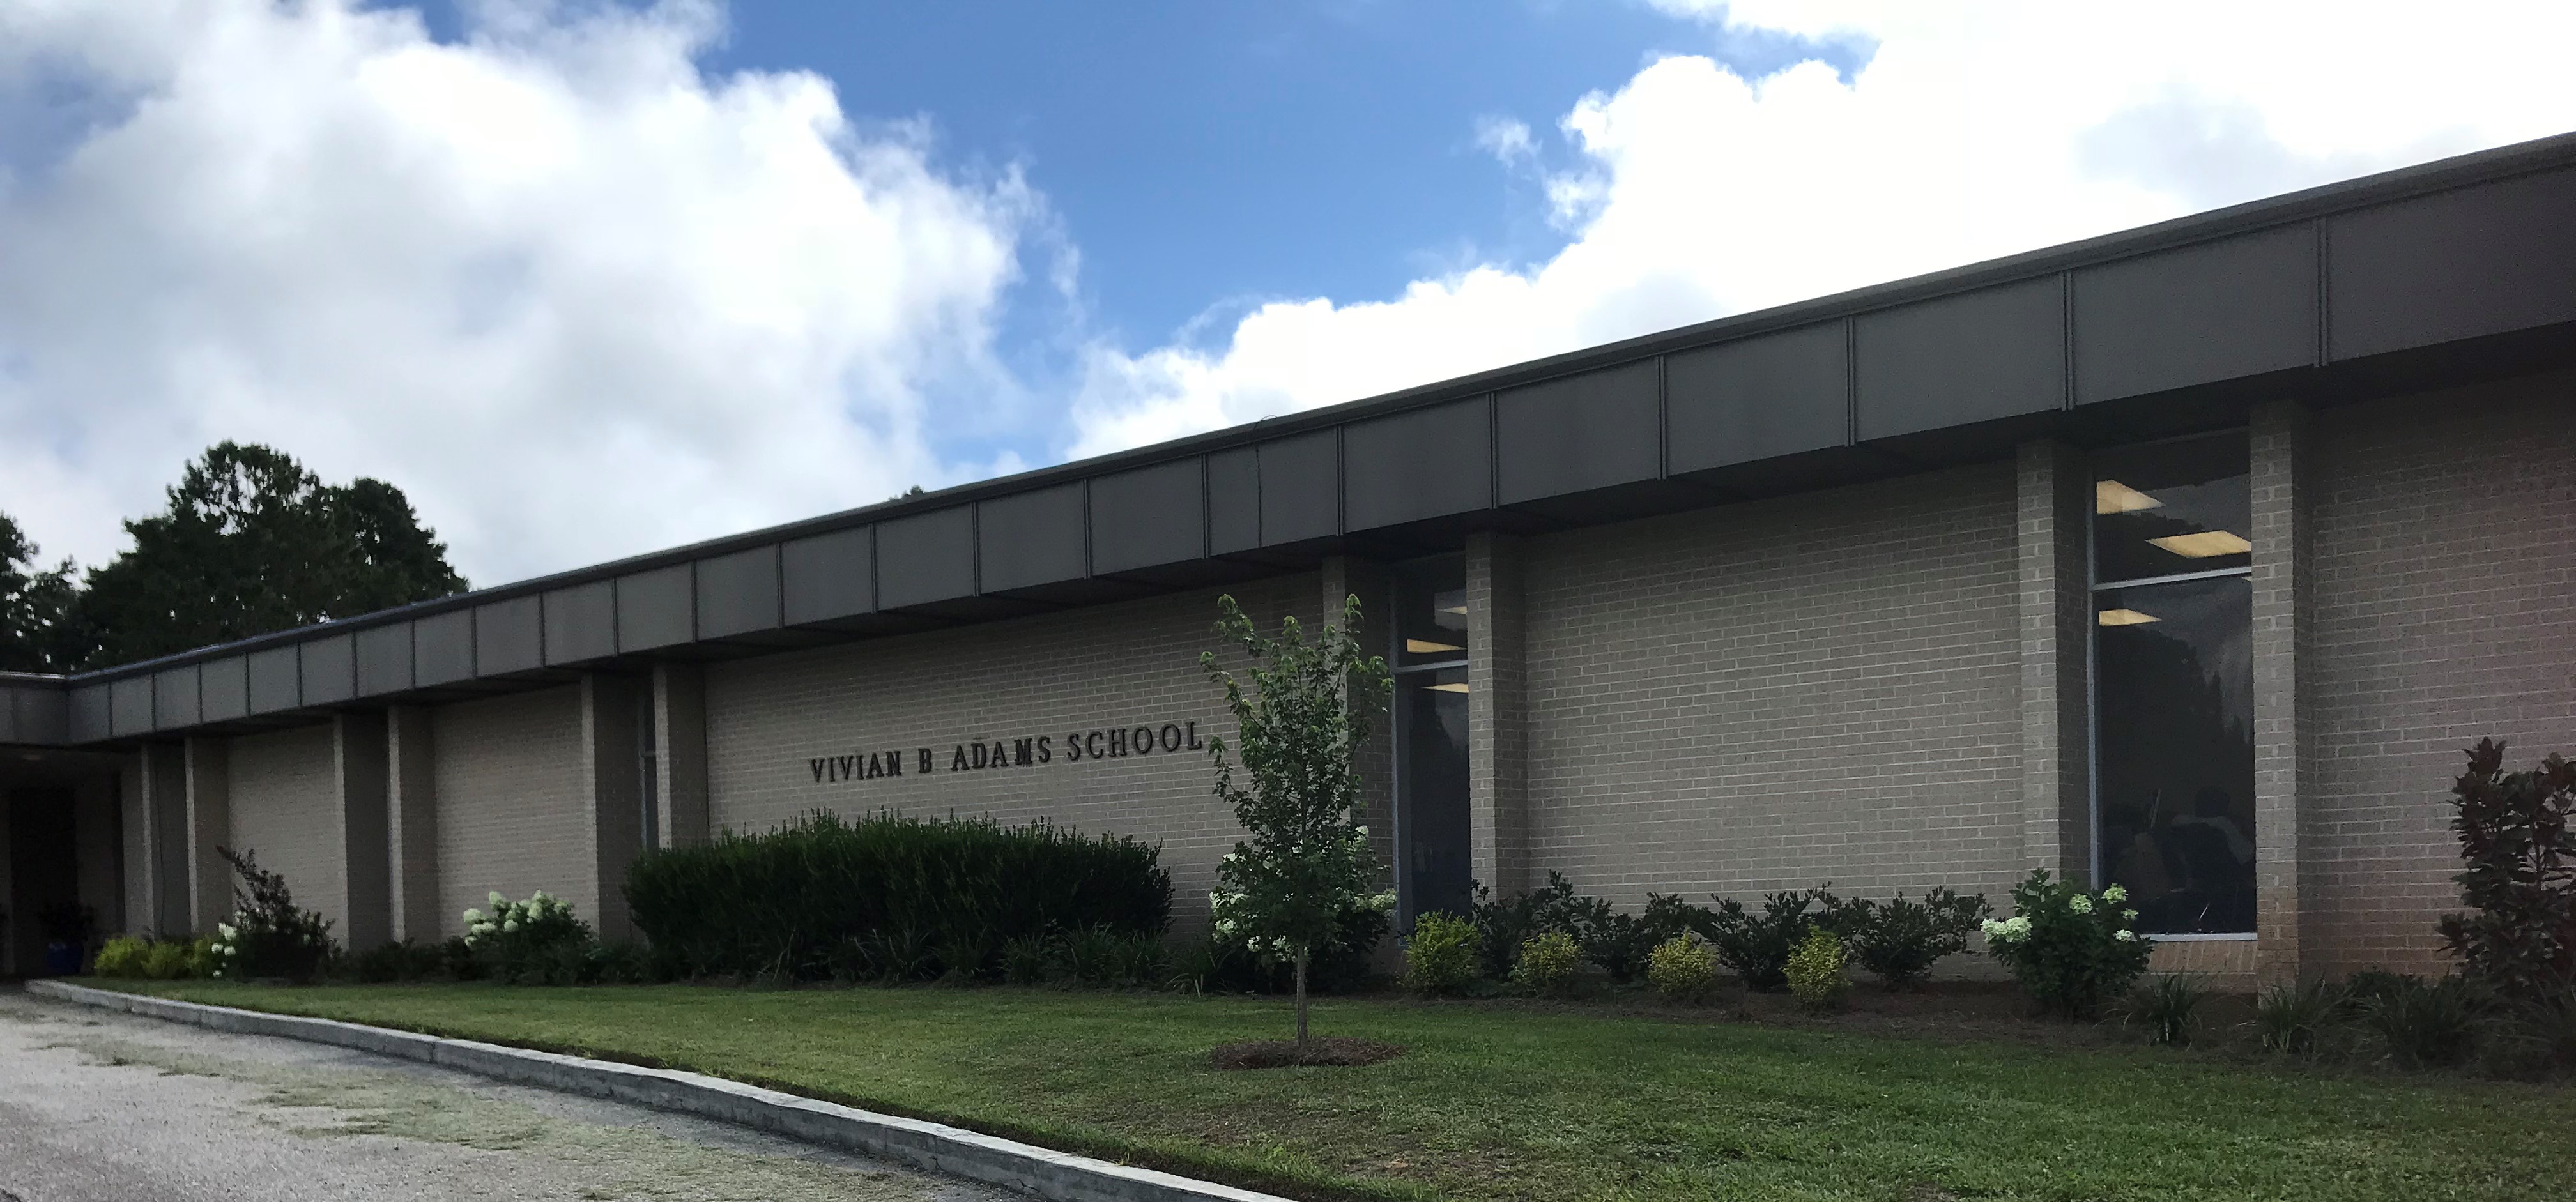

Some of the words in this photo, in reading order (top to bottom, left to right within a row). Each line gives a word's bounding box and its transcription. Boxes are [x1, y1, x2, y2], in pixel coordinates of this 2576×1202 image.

[809, 750, 901, 782] VIVIAN
[918, 748, 932, 773] B
[951, 736, 1051, 771] ADAMS
[1067, 721, 1202, 761] SCHOOL
